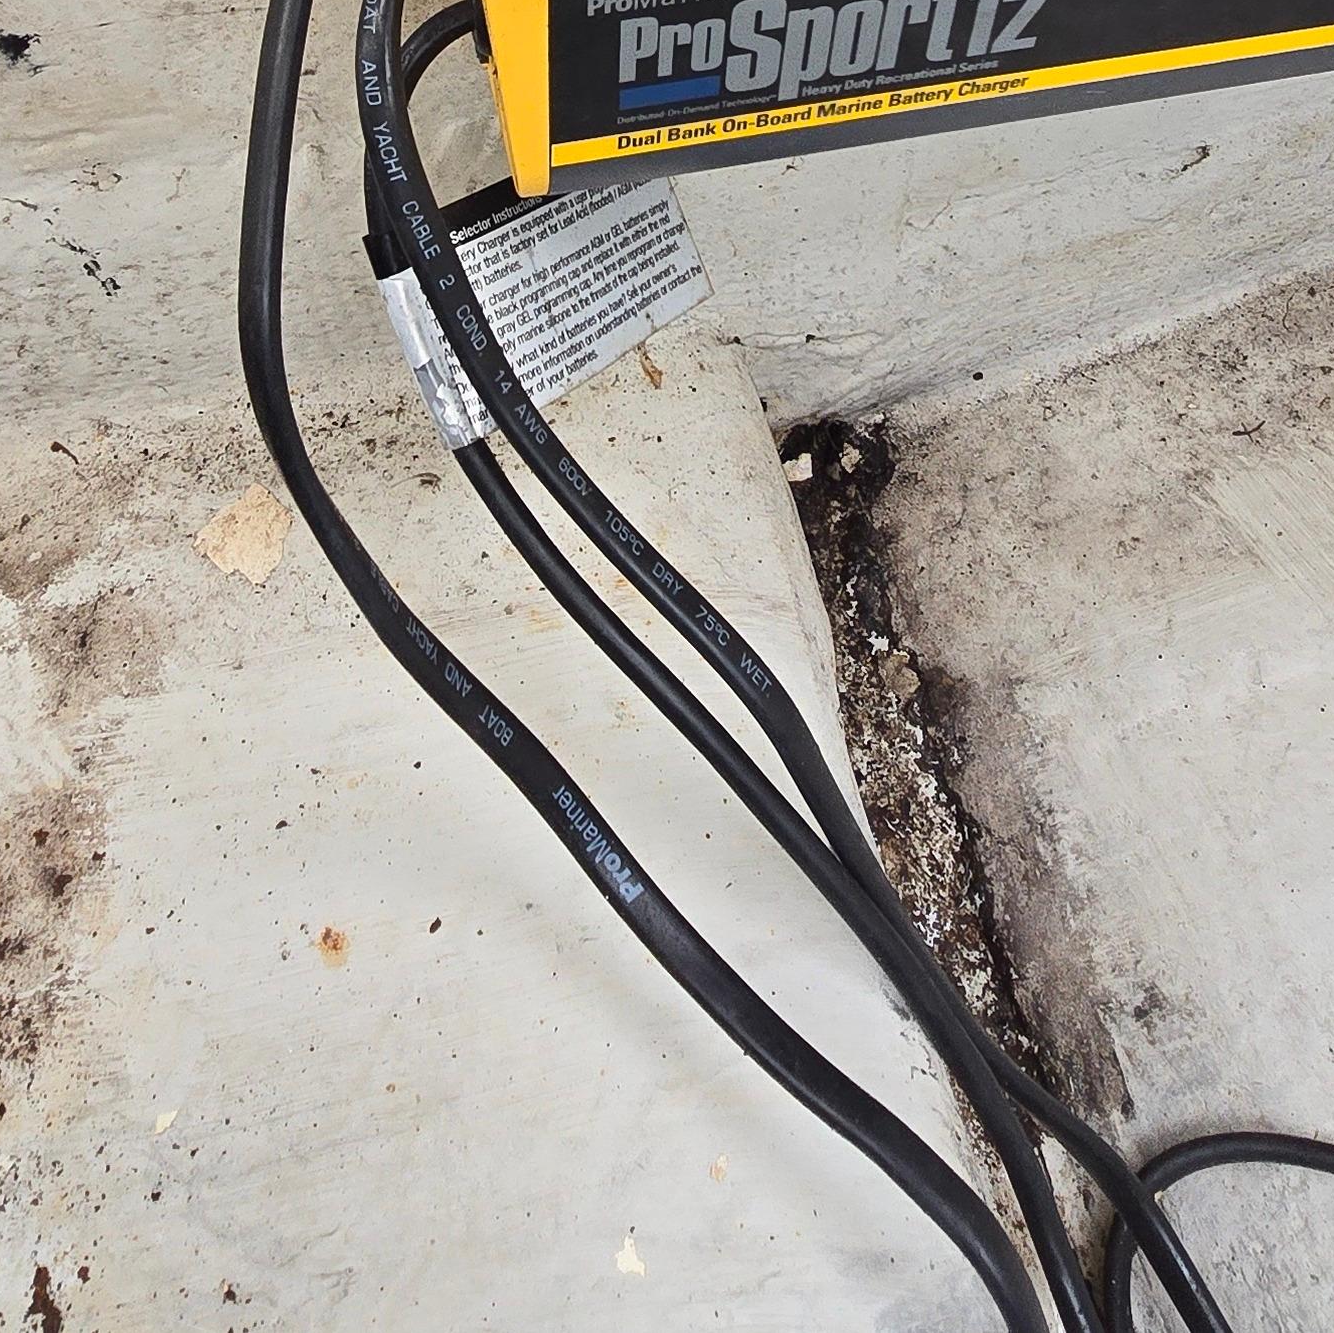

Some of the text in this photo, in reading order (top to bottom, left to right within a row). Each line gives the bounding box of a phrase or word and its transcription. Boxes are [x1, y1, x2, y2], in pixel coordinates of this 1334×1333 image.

[617, 76, 1029, 150] Dual Bank On-Board Marine Battery Charger
[802, 59, 999, 97] Heavy Duty Recreational Series
[449, 213, 491, 245] Selector
[477, 228, 511, 256] Charger
[510, 224, 519, 237] is
[519, 207, 553, 235] equipped
[553, 199, 567, 215] with
[484, 251, 500, 268] that
[500, 246, 509, 259] is
[510, 232, 535, 257] factory
[535, 227, 548, 242] set
[547, 220, 559, 235] for
[558, 211, 575, 229] Lead
[488, 280, 521, 309] charger
[520, 274, 532, 289] for
[532, 265, 549, 285] high
[549, 242, 590, 276] performance
[604, 232, 611, 242] or
[623, 209, 648, 231] batteries
[648, 197, 669, 219] simply
[494, 299, 517, 320] black
[519, 273, 568, 310] programming
[568, 266, 581, 282] cap
[580, 257, 593, 273] and
[593, 245, 614, 266] replace
[659, 213, 669, 226] red
[497, 319, 516, 339] gray
[533, 284, 579, 319] programming
[591, 268, 604, 284] Any
[616, 255, 628, 270] you
[627, 238, 656, 262] reprogram
[655, 234, 663, 244] or
[663, 219, 685, 242] change
[516, 320, 543, 345] marine
[570, 301, 579, 313] to
[579, 294, 590, 309] the
[590, 281, 612, 302] threads
[627, 265, 639, 280] cap
[638, 254, 654, 273] being
[361, 59, 382, 107] AND
[372, 121, 408, 183] YACHT
[402, 200, 442, 260] CABLE
[439, 273, 456, 290] 2
[493, 369, 513, 395] 14
[514, 403, 549, 446] AWG
[652, 561, 684, 596] DRY
[516, 347, 537, 368] what
[539, 336, 556, 355] kind
[556, 330, 566, 345] of
[566, 312, 596, 339] batteries
[597, 306, 610, 323] you
[608, 292, 626, 313] have?
[639, 278, 652, 295] your
[518, 364, 540, 384] more
[543, 338, 583, 371] information
[584, 333, 594, 346] on
[593, 304, 636, 339] understanding
[635, 287, 660, 311] batteries
[667, 269, 690, 291] contact
[690, 262, 701, 277] the
[535, 377, 546, 392] of
[548, 368, 565, 389] your
[405, 617, 439, 665] YACHT
[445, 661, 473, 697] AND
[478, 704, 514, 747] BOAT
[552, 785, 645, 903] ProMariner
